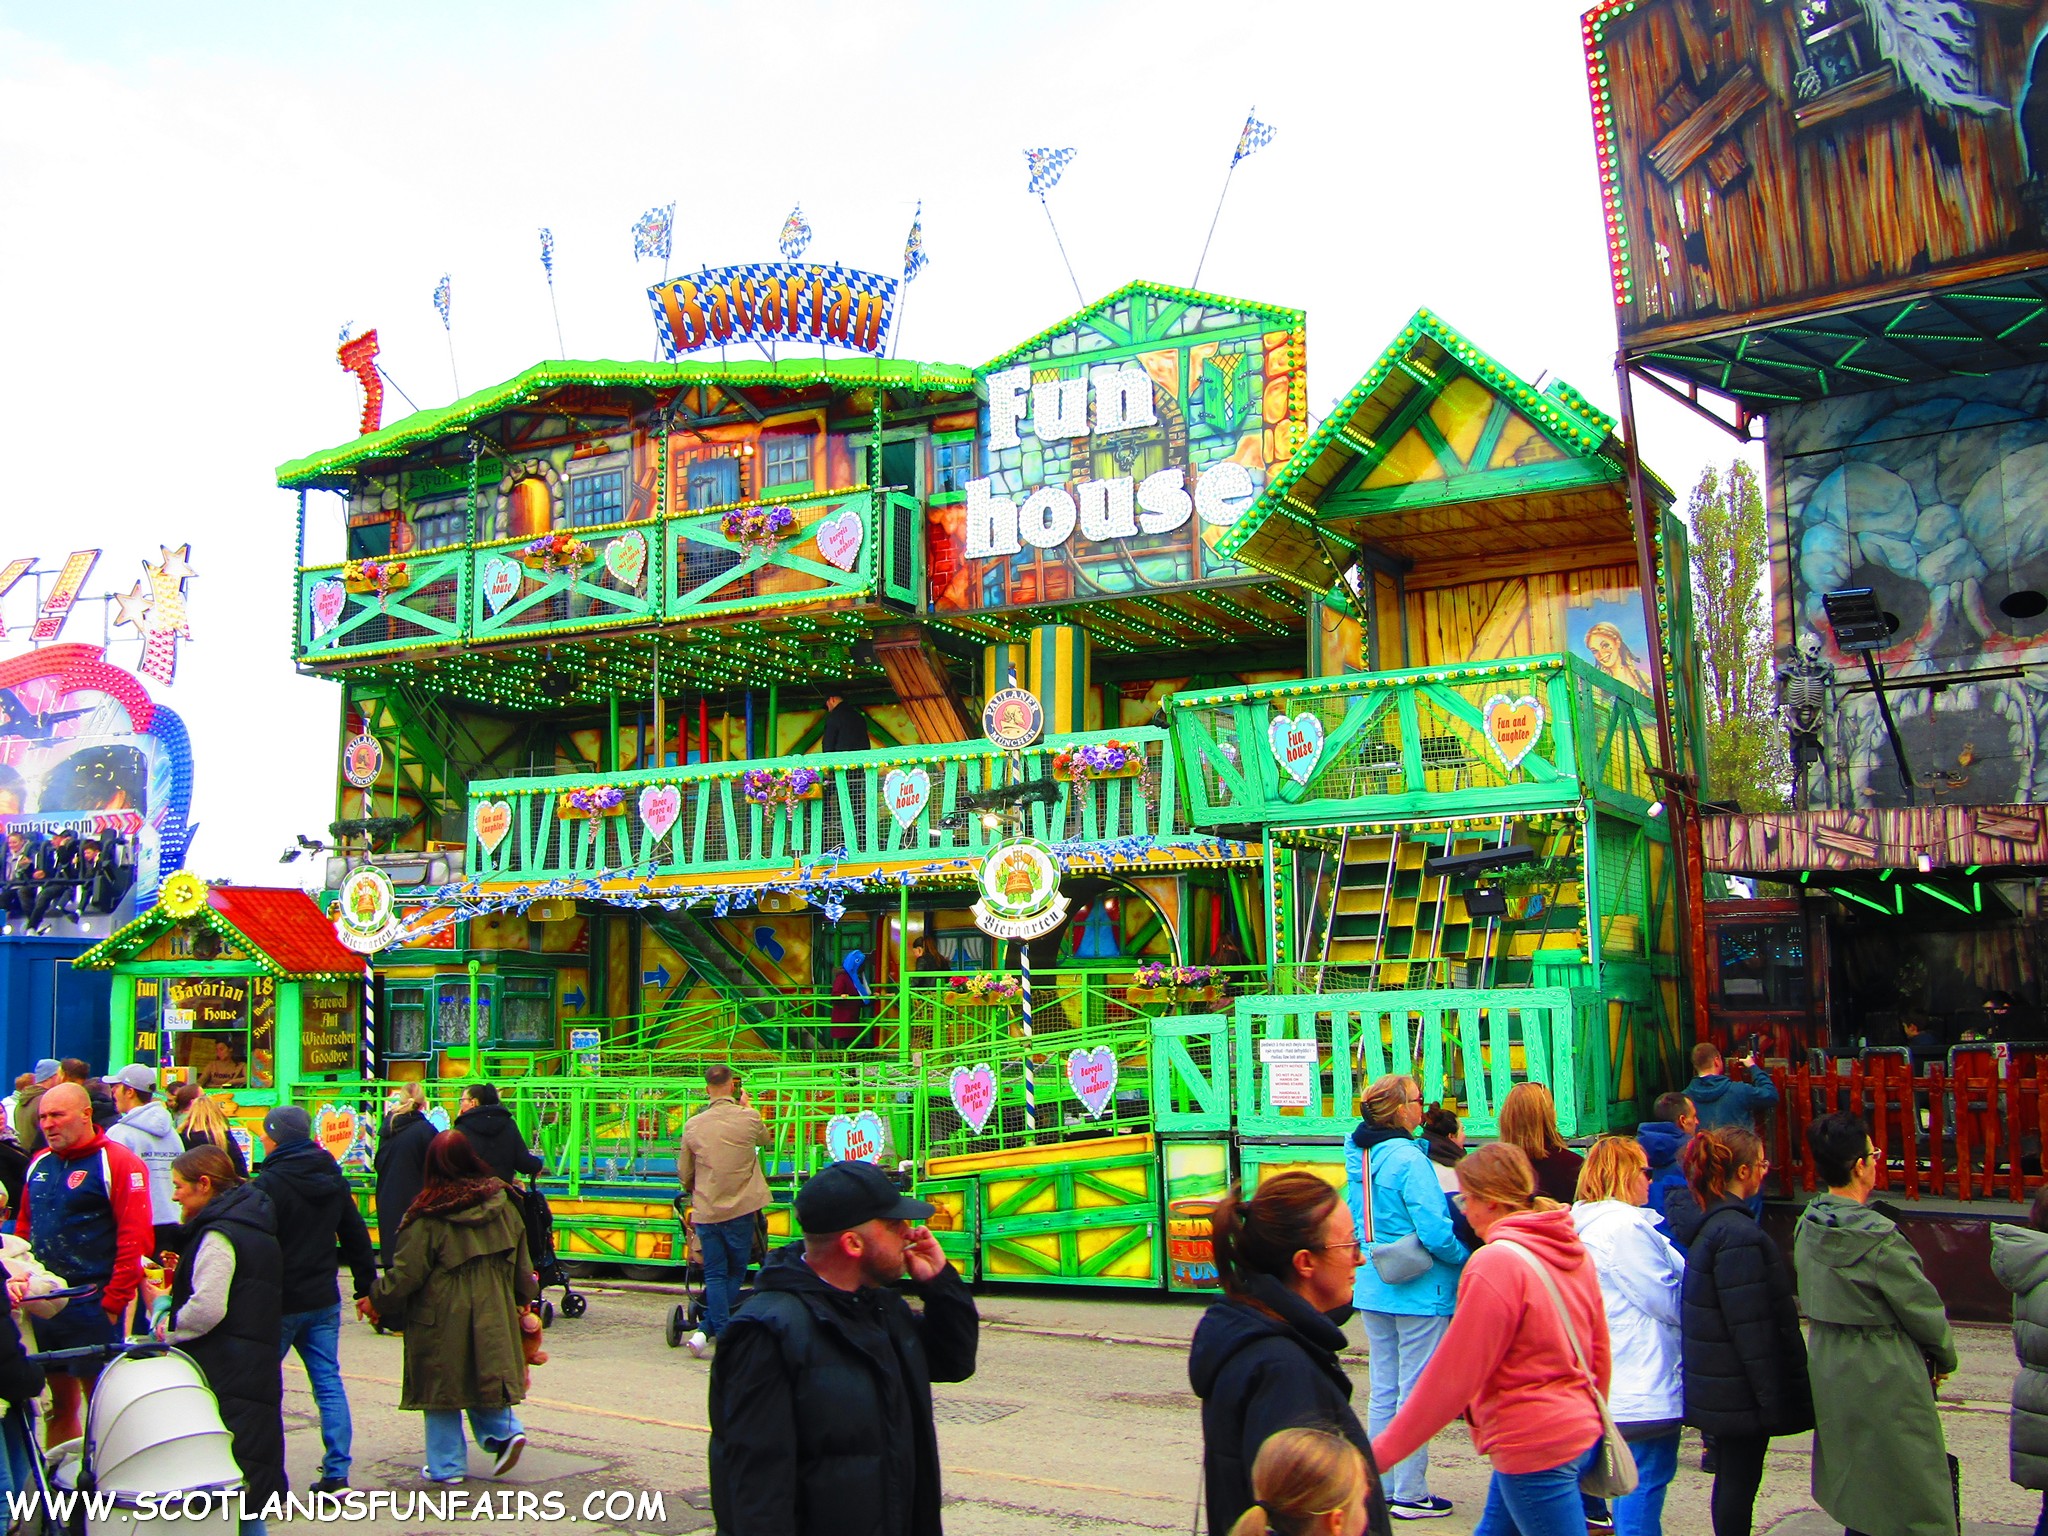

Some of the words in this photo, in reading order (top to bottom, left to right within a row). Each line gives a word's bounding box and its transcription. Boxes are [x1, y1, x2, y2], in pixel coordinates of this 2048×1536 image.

[653, 265, 884, 353] Bavarian
[986, 365, 1158, 452] Fun
[965, 461, 1254, 560] house
[496, 571, 508, 584] Fun
[492, 583, 512, 595] house
[986, 690, 1039, 716] PAULANER
[1498, 717, 1510, 729] Fun
[1512, 714, 1527, 727] and
[1287, 730, 1305, 747] Fun
[1497, 729, 1530, 744] Laughter
[346, 736, 381, 757] PAULANER
[1286, 741, 1313, 763] house
[900, 782, 914, 796] Fun
[896, 793, 920, 809] house
[168, 981, 244, 1003] Bavarian
[253, 976, 274, 996] 18
[312, 994, 348, 1010] Farewell
[204, 1006, 237, 1022] House
[320, 1012, 338, 1028] Auf
[252, 1018, 274, 1039] Floors
[135, 1031, 157, 1051] All
[302, 1030, 357, 1046] Wiedersehen
[311, 1049, 348, 1066] Goodbye
[1996, 1045, 2007, 1058] 2
[964, 1081, 981, 1094] Three
[972, 1100, 983, 1112] fun
[326, 1121, 336, 1132] Fun
[338, 1118, 349, 1129] and
[847, 1129, 865, 1147] Fun
[844, 1140, 874, 1161] house
[1168, 1218, 1214, 1237] FUN
[1171, 1239, 1214, 1259] FUN
[1174, 1261, 1220, 1281] FUN
